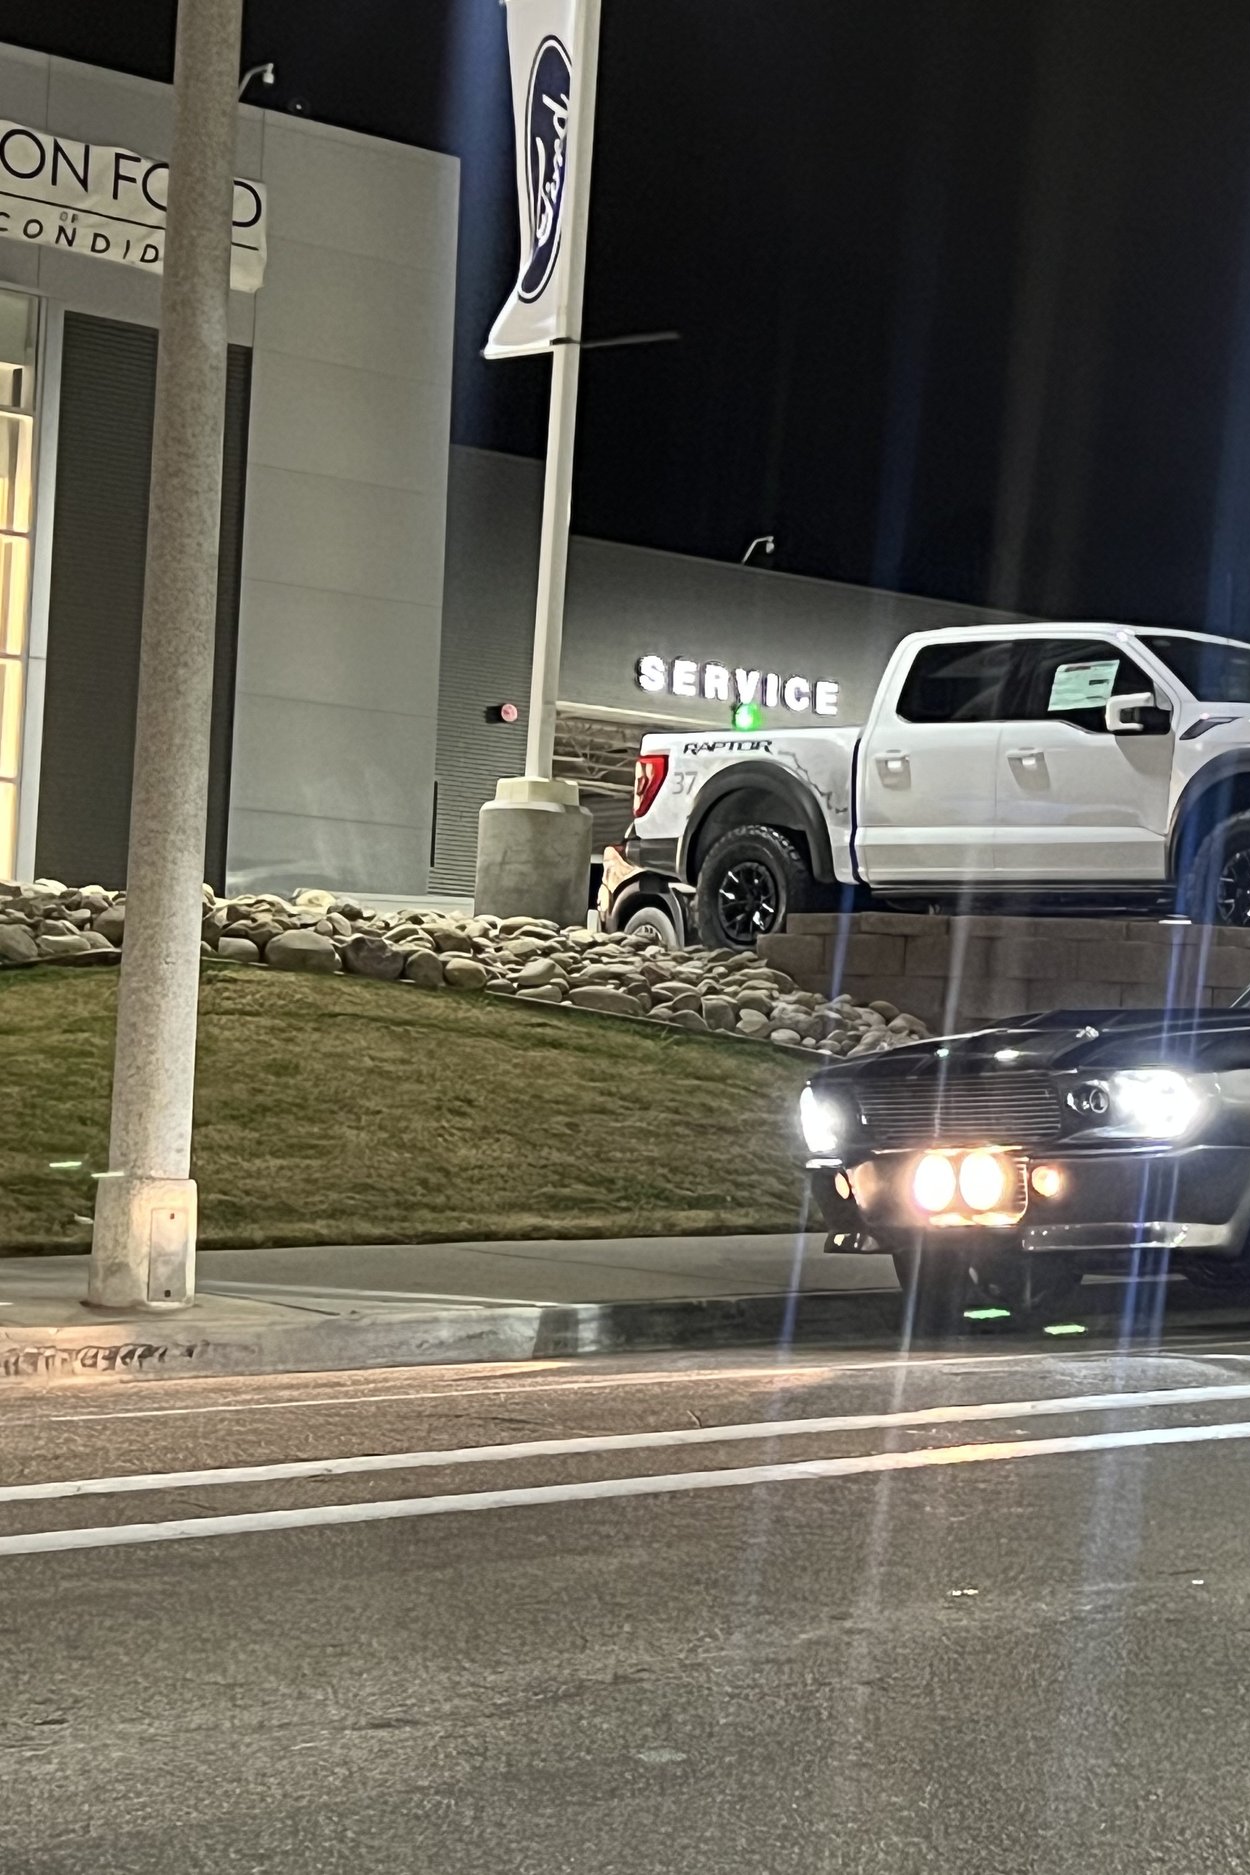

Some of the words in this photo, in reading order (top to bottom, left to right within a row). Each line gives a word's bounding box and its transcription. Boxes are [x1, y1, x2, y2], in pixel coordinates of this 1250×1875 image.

[112, 152, 262, 228] FOD
[535, 92, 569, 248] Ford
[635, 654, 840, 716] SERVICE
[683, 739, 773, 755] RAPTOR
[673, 771, 698, 795] 37
